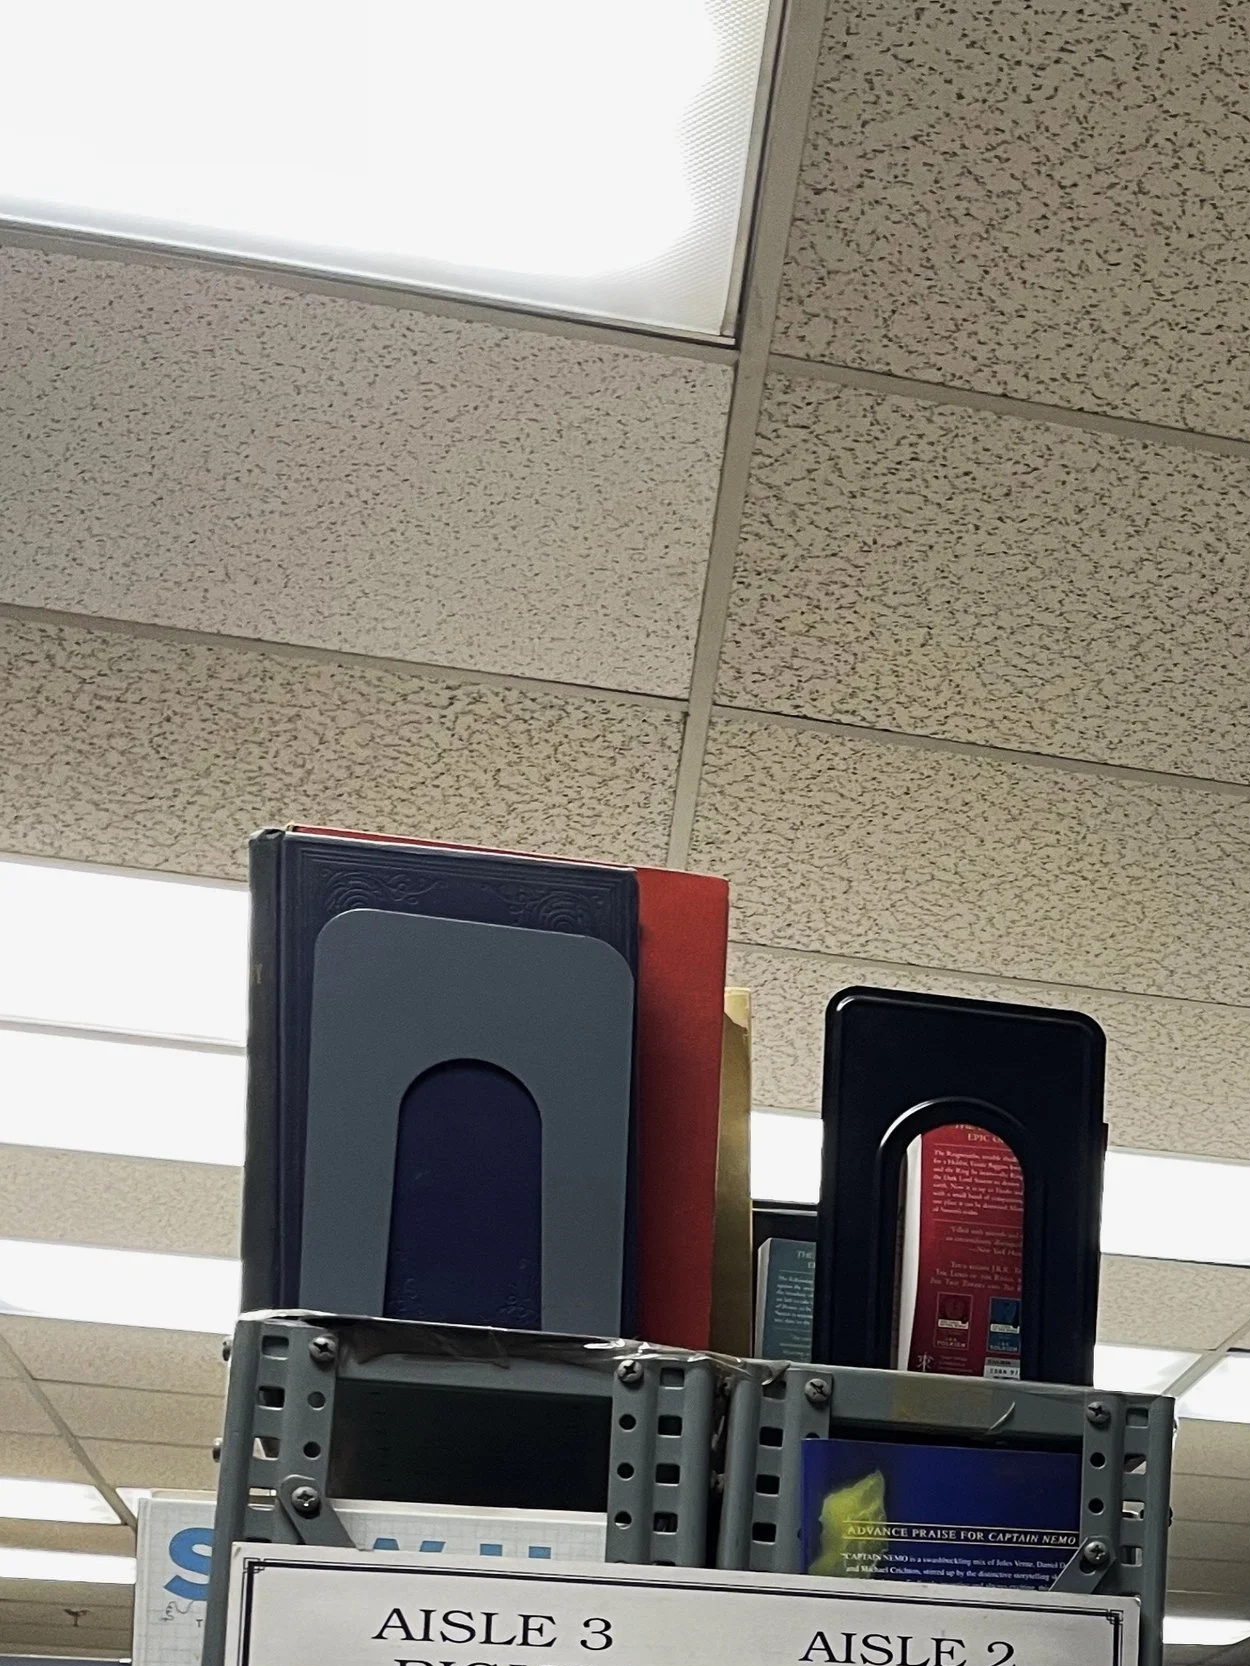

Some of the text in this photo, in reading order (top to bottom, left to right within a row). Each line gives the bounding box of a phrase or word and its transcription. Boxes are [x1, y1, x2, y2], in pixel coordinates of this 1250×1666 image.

[847, 1526, 1076, 1545] ADVANCE PRAISE FOR CAPTAIN NEMO
[372, 1608, 612, 1650] AISLE 3
